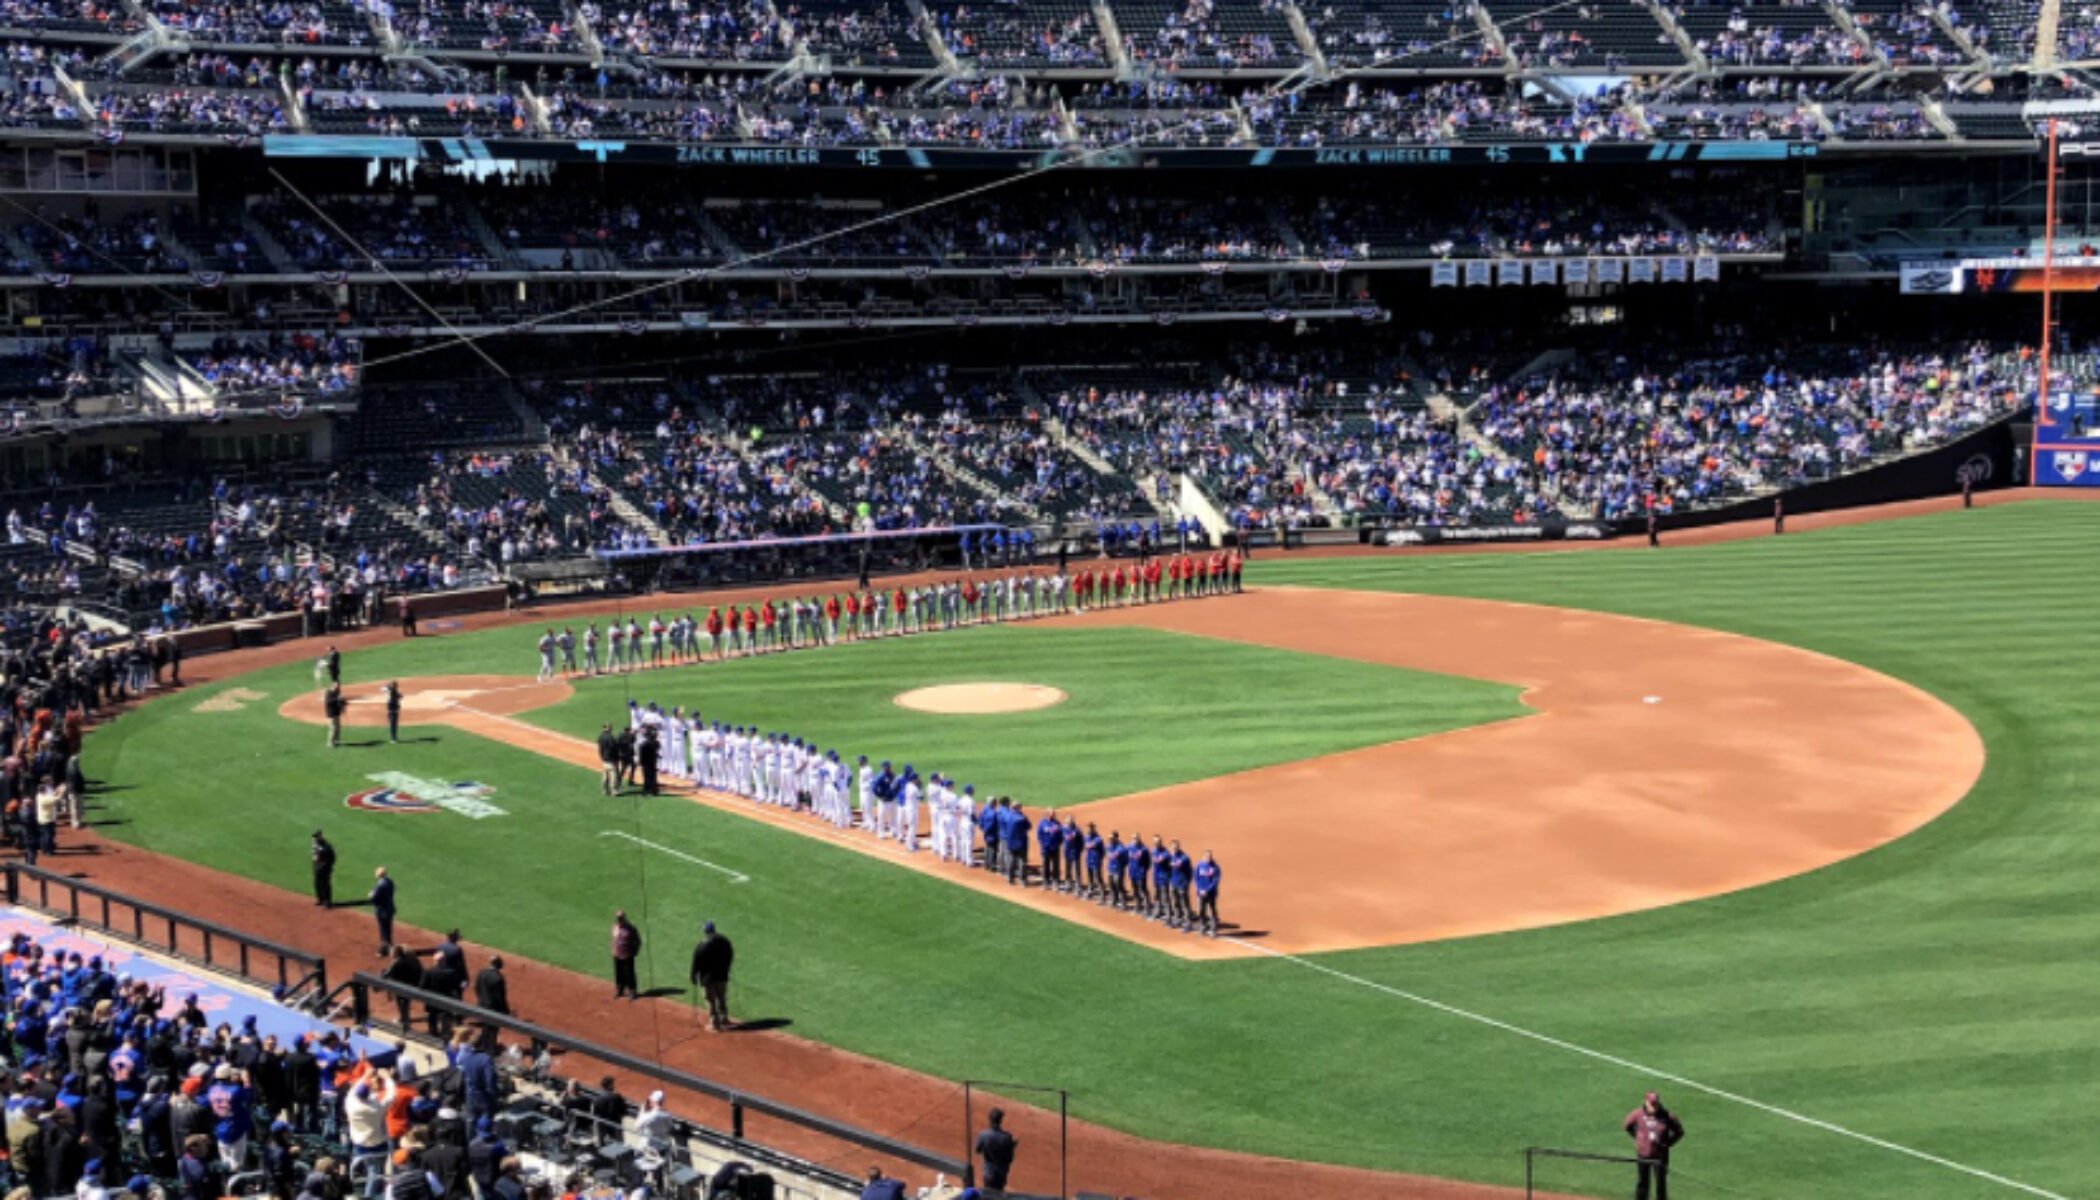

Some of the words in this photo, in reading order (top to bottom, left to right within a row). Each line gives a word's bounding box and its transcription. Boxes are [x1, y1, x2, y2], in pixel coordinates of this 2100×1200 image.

[677, 147, 725, 163] ZACK
[731, 148, 820, 164] WHEELER
[855, 149, 880, 165] 45
[1315, 149, 1360, 164] ZACK
[1367, 148, 1450, 164] WHEELER
[1485, 146, 1510, 163] 45
